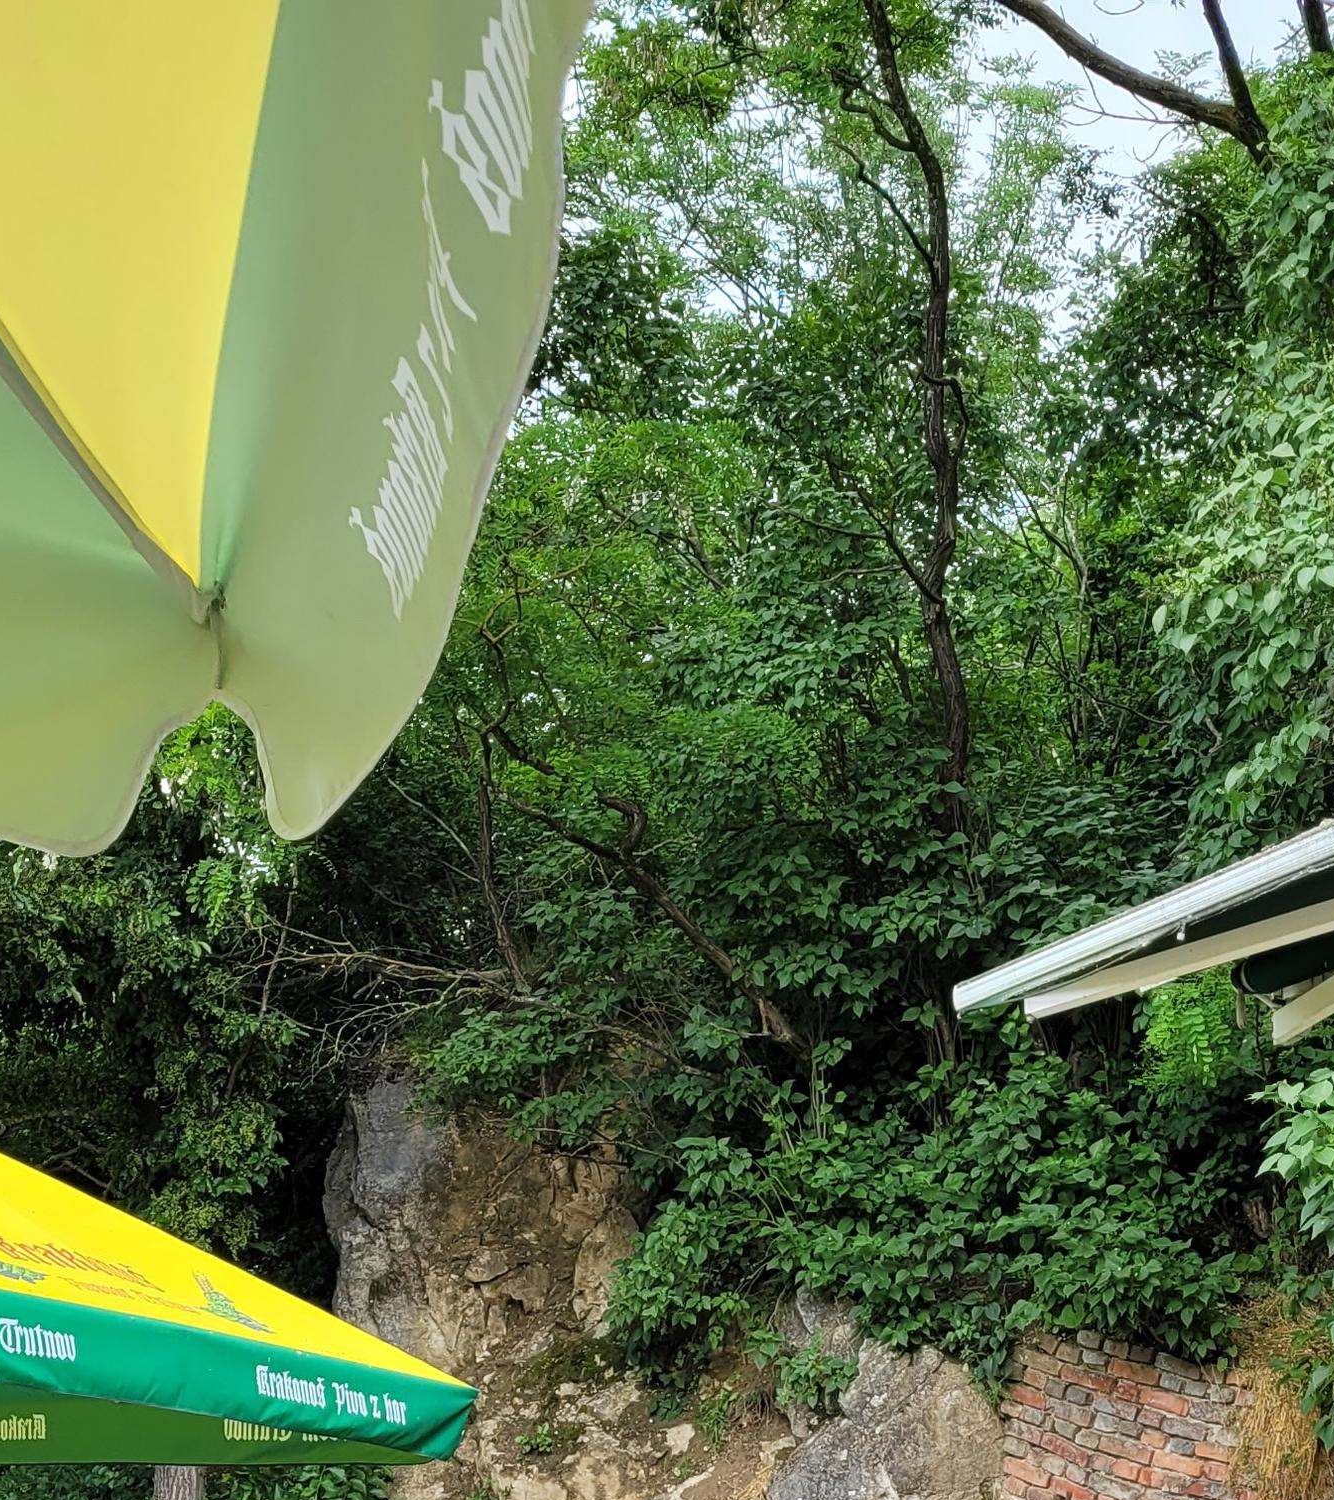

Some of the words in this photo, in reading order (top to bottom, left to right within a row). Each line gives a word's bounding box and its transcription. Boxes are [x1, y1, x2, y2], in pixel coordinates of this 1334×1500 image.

[255, 1364, 327, 1409] Krakonoš
[331, 1382, 369, 1416] Pivo
[370, 1396, 381, 1419] z
[383, 1392, 407, 1426] hor
